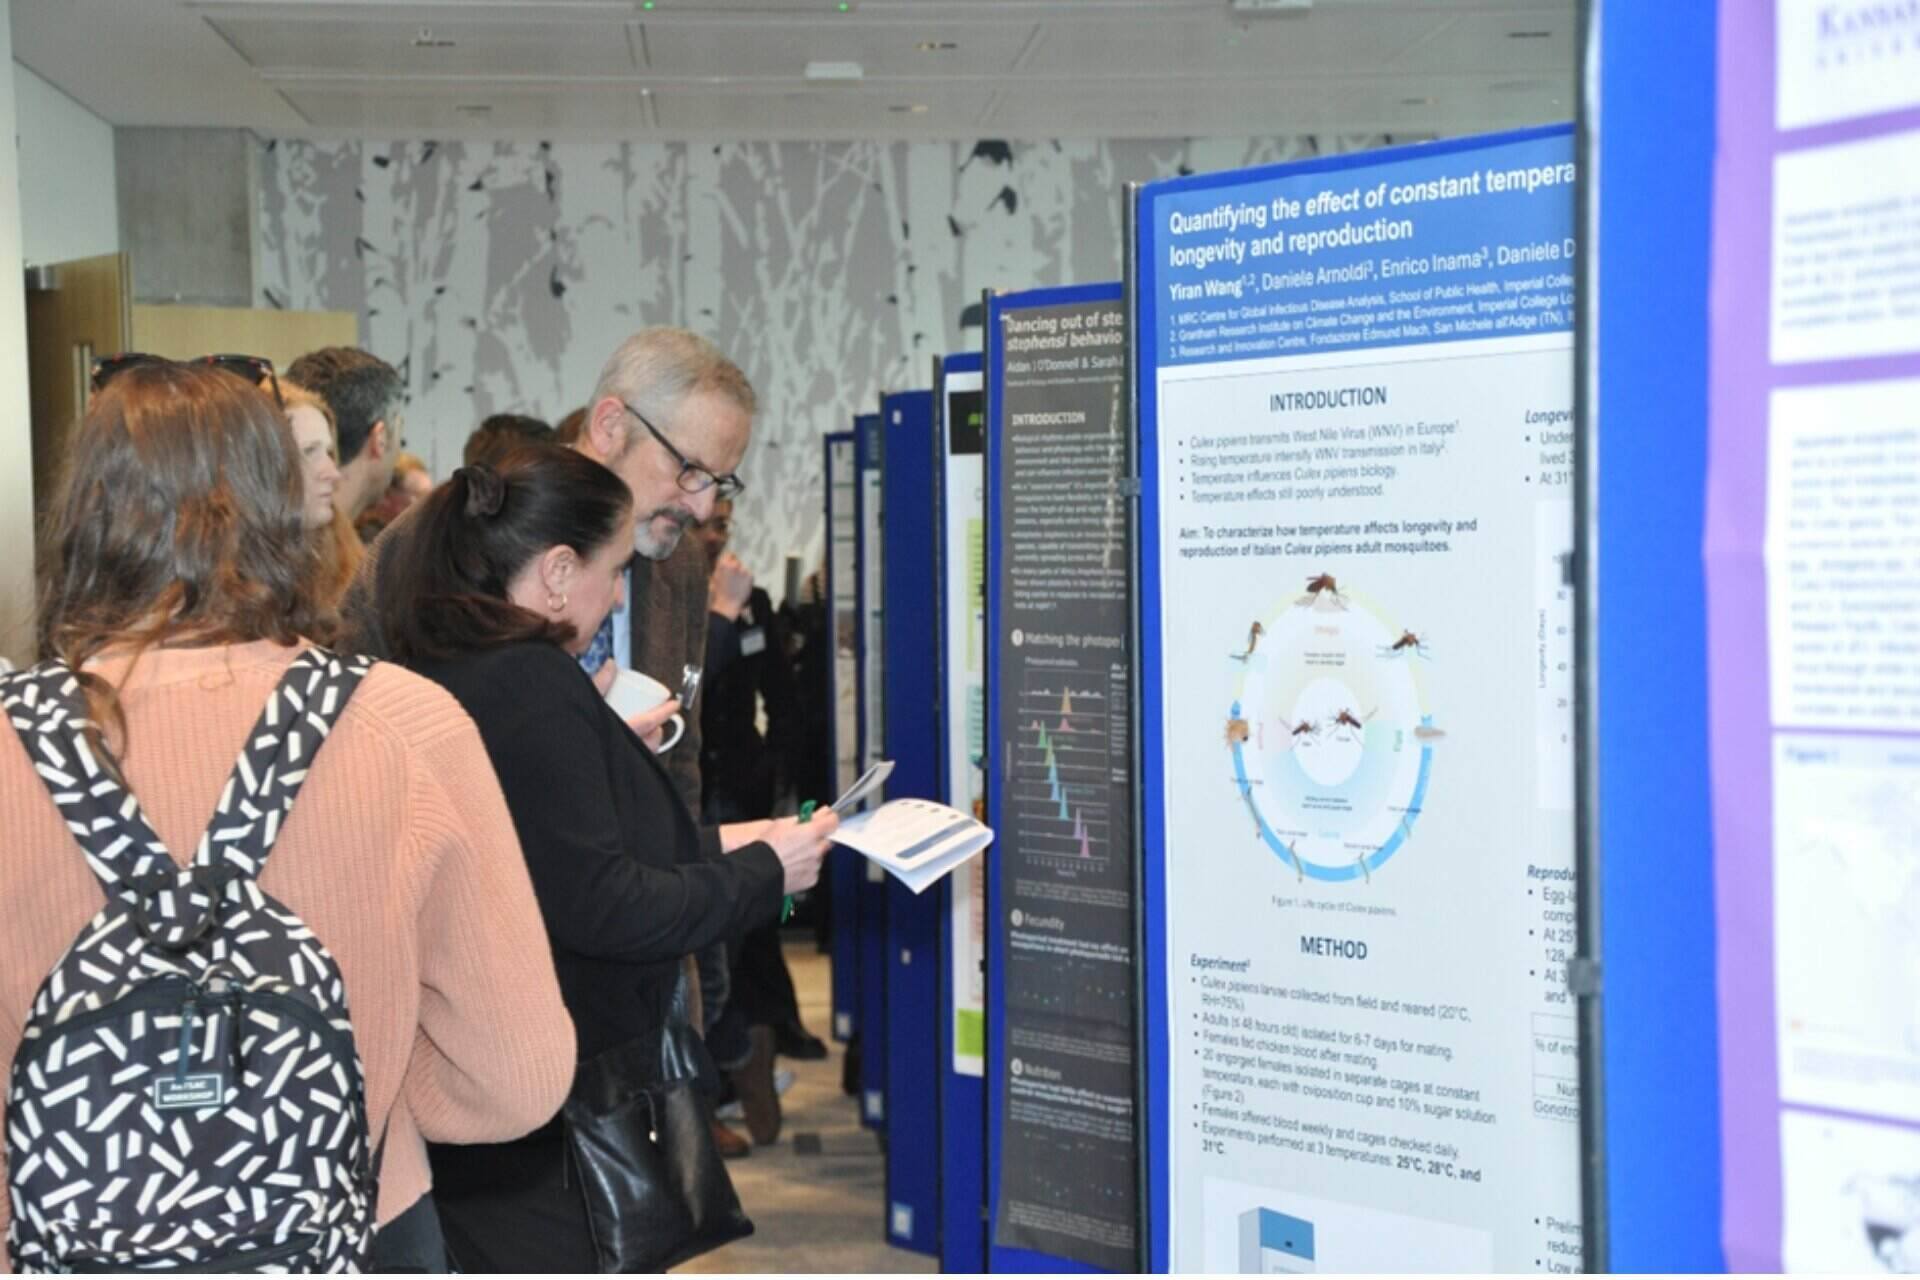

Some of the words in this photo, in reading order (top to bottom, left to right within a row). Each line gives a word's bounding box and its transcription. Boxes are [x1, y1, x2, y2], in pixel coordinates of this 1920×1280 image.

[1169, 203, 1267, 235] Quantifying
[1272, 197, 1300, 221] the
[1305, 187, 1360, 216] effect
[1364, 181, 1387, 209] of
[1390, 171, 1481, 206] constant
[1486, 162, 1576, 194] tempera
[1169, 238, 1246, 269] longevity
[1251, 230, 1284, 257] and
[1289, 217, 1412, 255] reproduction
[1169, 282, 1202, 301] Yiran
[1262, 270, 1313, 291] Daniele
[1381, 254, 1429, 278] Enrico
[1497, 241, 1560, 265] Daniele
[1060, 314, 1082, 330] out
[1085, 311, 1099, 327] of
[1270, 386, 1387, 411] INTRODUCTION
[1011, 411, 1086, 426] INTRODUCTION
[1292, 427, 1318, 443] West
[1319, 426, 1338, 441] Nile
[1342, 425, 1366, 440] Virus
[1368, 423, 1403, 442] (WNV)
[1405, 422, 1414, 437] in
[1314, 446, 1338, 460] WNV
[1342, 443, 1404, 459] transmission
[1408, 442, 1418, 455] in
[1192, 469, 1244, 487] Temperature
[1294, 466, 1321, 480] Culex
[1192, 488, 1244, 505] Temperature
[1202, 524, 1214, 538] To
[1216, 523, 1274, 538] characterize
[1276, 523, 1296, 536] how
[1299, 521, 1360, 539] temperature
[1364, 520, 1399, 534] affects
[1402, 519, 1452, 536] longevity
[1456, 518, 1478, 532] and
[1180, 543, 1238, 560] reproduction
[1240, 543, 1250, 556] of
[1284, 542, 1313, 555] Culex
[1314, 541, 1352, 558] pipiens
[1355, 540, 1382, 554] adult
[1300, 935, 1367, 960] METHOD
[1332, 991, 1354, 1007] from
[1356, 995, 1378, 1010] field
[1380, 1000, 1400, 1013] and
[1402, 1004, 1436, 1018] reared
[1338, 1030, 1352, 1044] for
[1374, 1035, 1398, 1053] days
[1399, 1039, 1414, 1053] for
[1333, 1067, 1342, 1081] in
[1344, 1072, 1388, 1088] separate
[1390, 1079, 1421, 1094] cages
[1424, 1082, 1434, 1095] at
[1436, 1086, 1480, 1102] constant
[1354, 1092, 1374, 1107] cup
[1376, 1094, 1396, 1107] and
[1423, 1103, 1453, 1117] sugar
[1455, 1106, 1496, 1123] solution
[1273, 1114, 1298, 1131] blood
[1302, 1122, 1333, 1139] weekly
[1335, 1127, 1354, 1140] and
[1356, 1132, 1386, 1147] cages
[1388, 1135, 1432, 1154] checked
[1202, 1120, 1256, 1142] Experiments
[1257, 1133, 1304, 1151] performed
[1396, 1155, 1426, 1175] 25°C,
[1428, 1161, 1457, 1181] 28°C,
[1460, 1169, 1482, 1182] and
